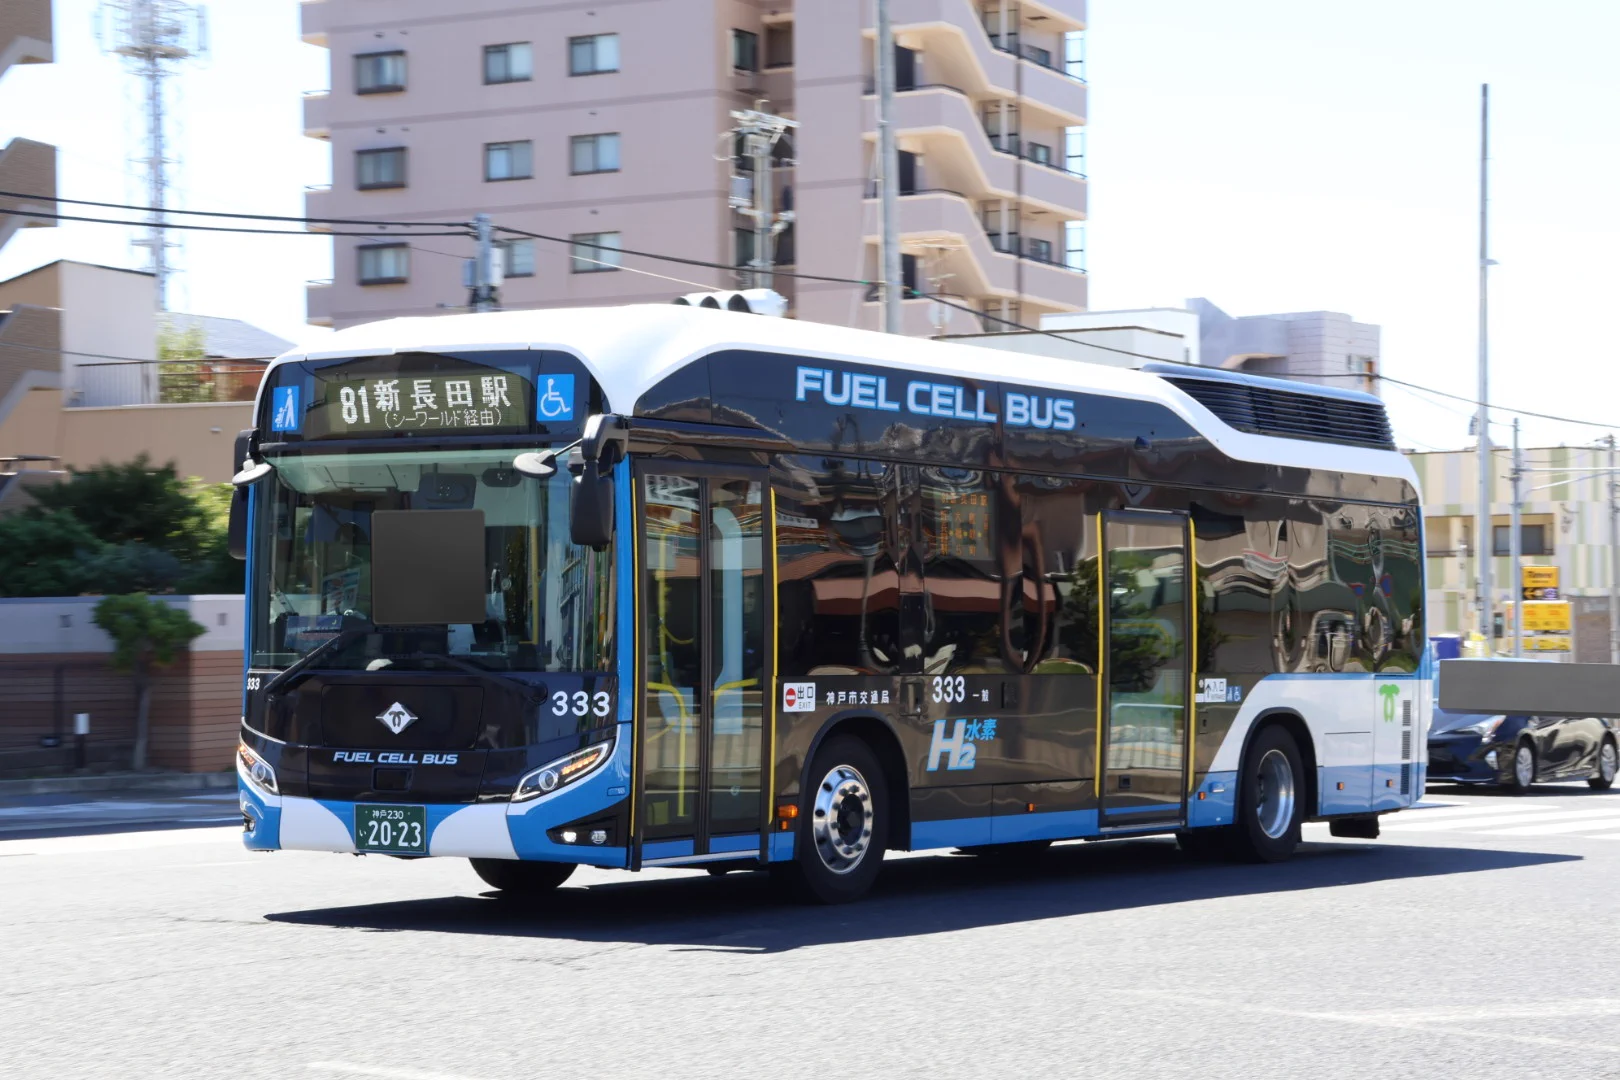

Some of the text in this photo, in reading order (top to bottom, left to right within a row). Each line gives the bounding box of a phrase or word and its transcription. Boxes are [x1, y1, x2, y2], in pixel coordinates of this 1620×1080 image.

[339, 376, 511, 424] 81 新長田駅
[796, 366, 1076, 431] FUEL CELL BUS
[247, 677, 260, 690] 333
[797, 686, 814, 699] 出口
[932, 676, 966, 703] 333
[552, 691, 610, 716] 333
[798, 701, 812, 709] EXIT
[826, 690, 890, 705] 神戸市交通局
[965, 718, 998, 741] 水素
[333, 751, 458, 765] FUEL CELL BUS
[368, 820, 421, 847] 20-23
